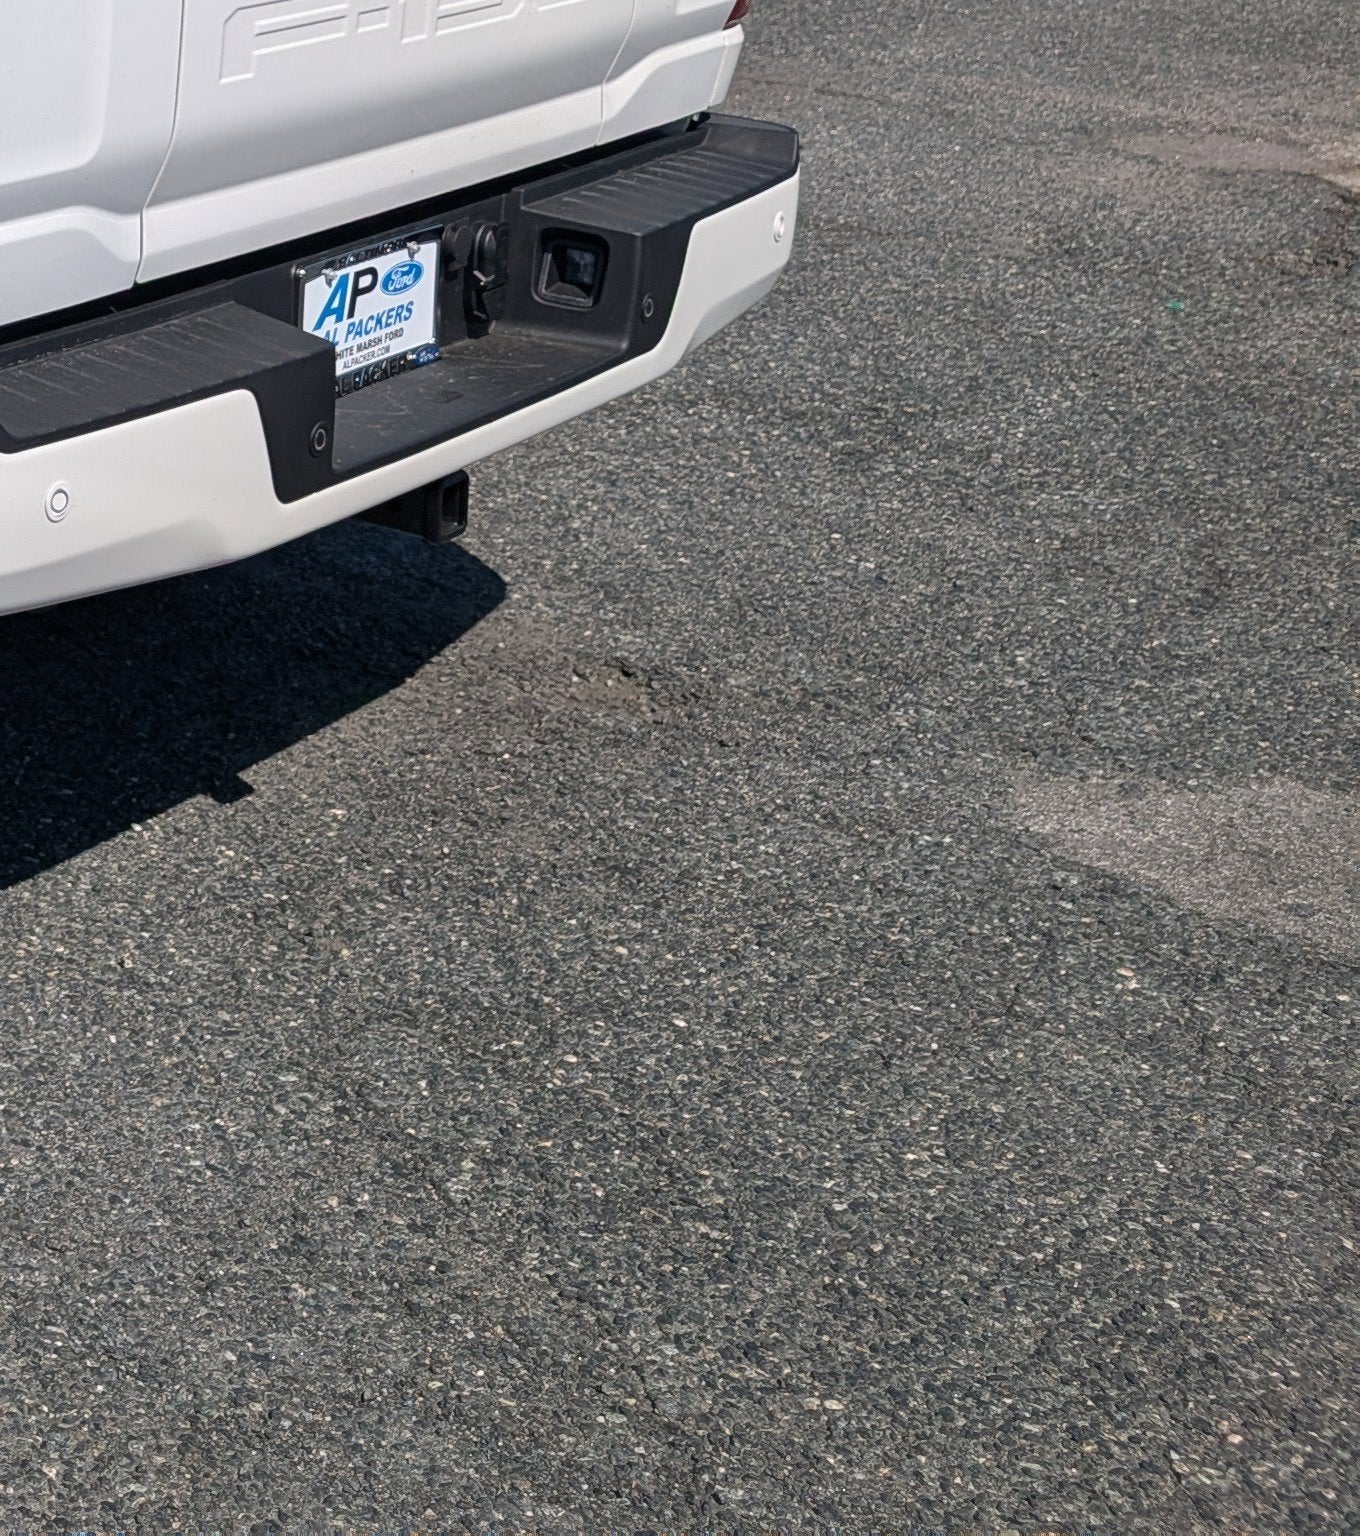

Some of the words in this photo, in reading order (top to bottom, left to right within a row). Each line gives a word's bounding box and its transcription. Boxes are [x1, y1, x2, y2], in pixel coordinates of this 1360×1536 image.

[312, 267, 379, 332] AP
[387, 265, 417, 292] Ford
[336, 348, 354, 360] HITE
[356, 338, 383, 352] MARSH
[384, 327, 404, 344] FORD
[344, 300, 415, 344] PACKERS
